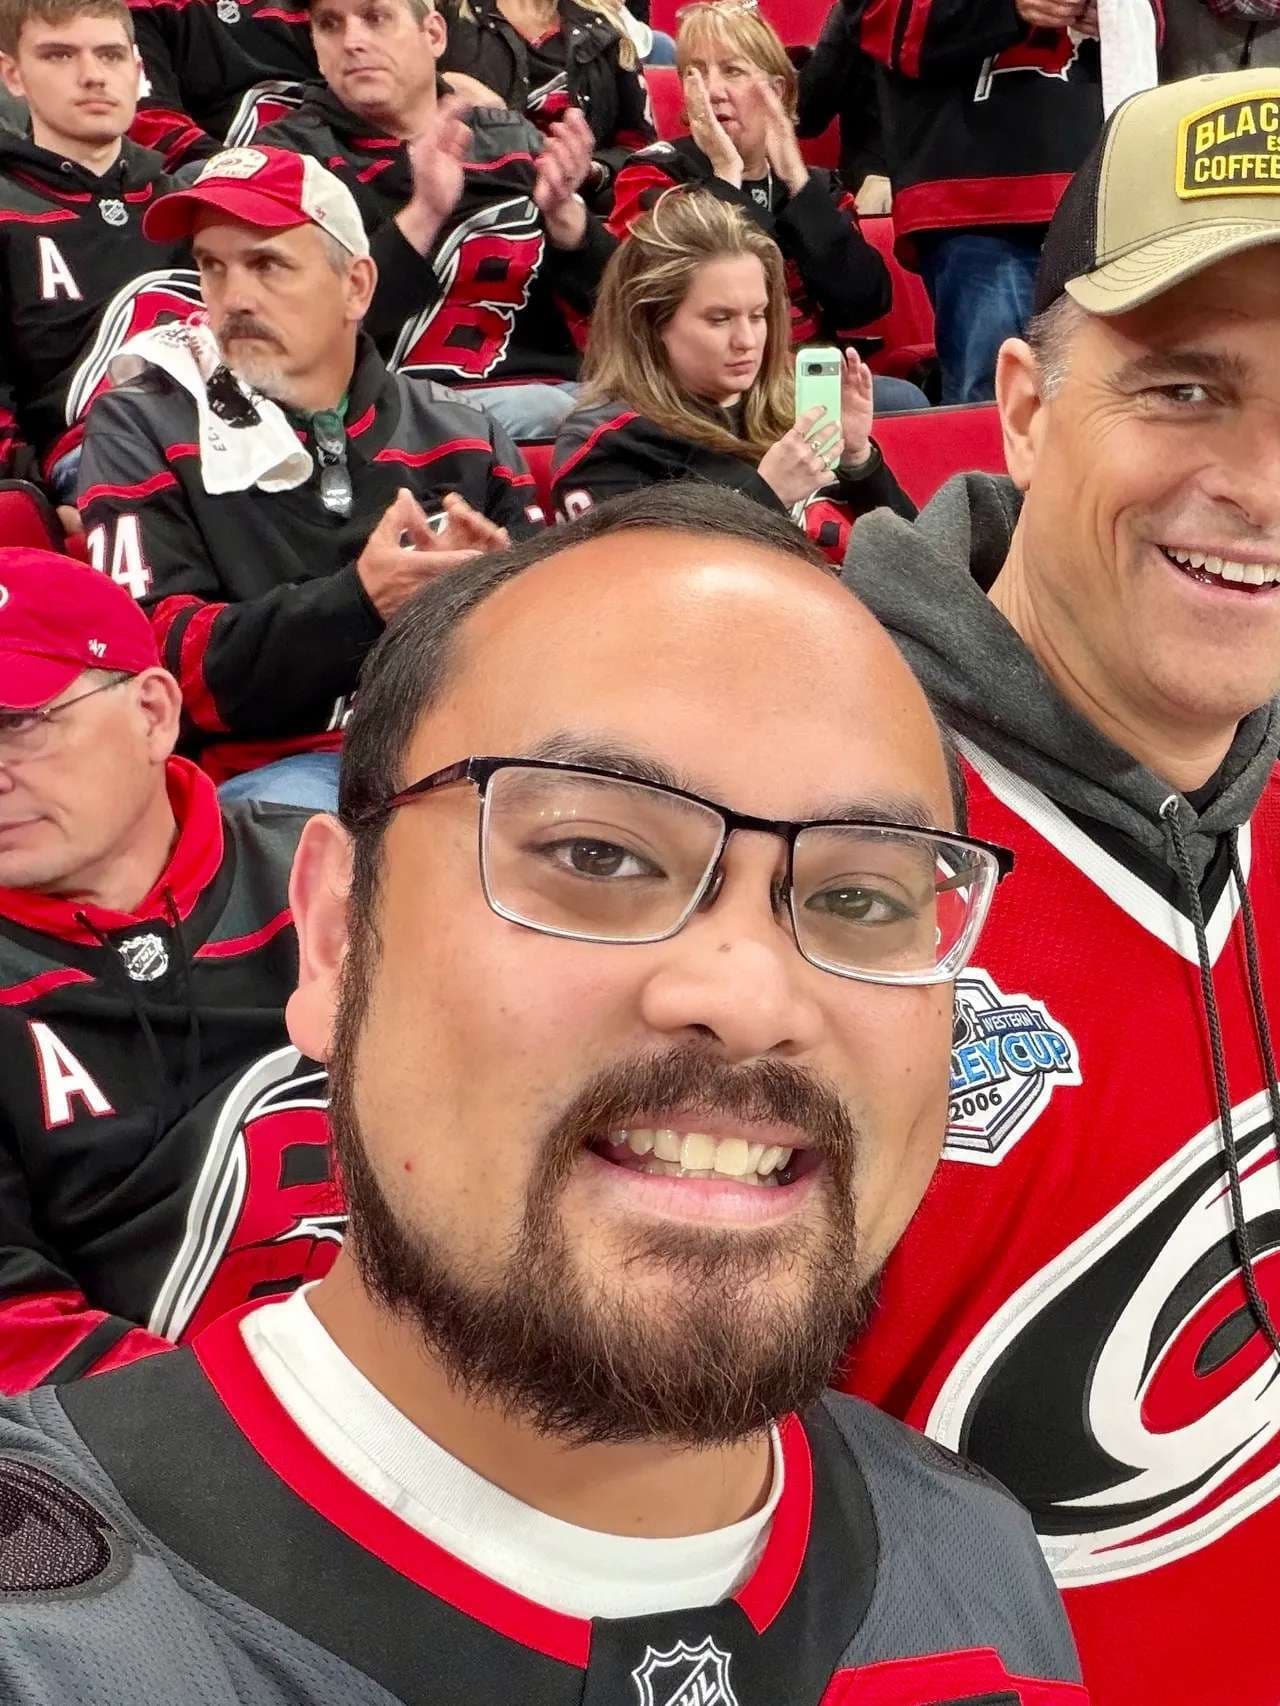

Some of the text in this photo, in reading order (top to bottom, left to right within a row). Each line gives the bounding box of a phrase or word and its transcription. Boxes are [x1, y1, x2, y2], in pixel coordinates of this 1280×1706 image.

[38, 235, 83, 300] A
[86, 513, 152, 600] 14
[981, 1011, 1031, 1033] WESTERN
[28, 1017, 117, 1130] A
[1001, 1031, 1070, 1071] CUP
[949, 1087, 1002, 1122] 2006
